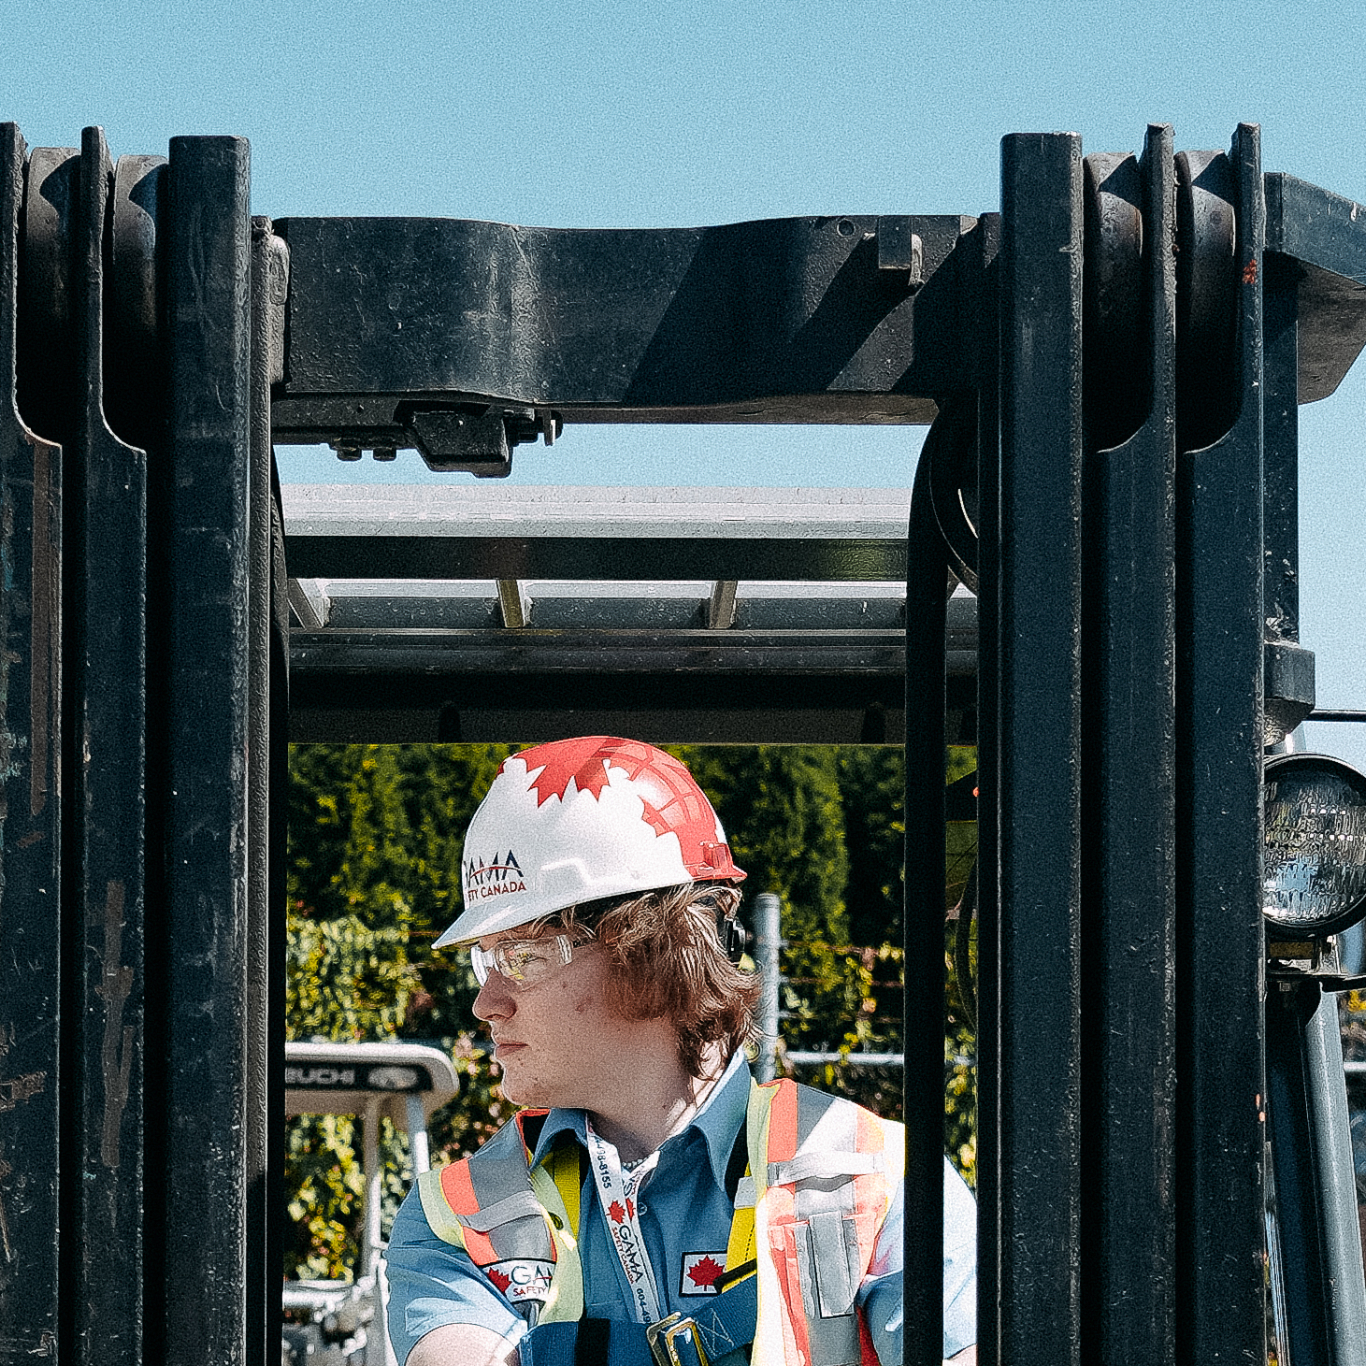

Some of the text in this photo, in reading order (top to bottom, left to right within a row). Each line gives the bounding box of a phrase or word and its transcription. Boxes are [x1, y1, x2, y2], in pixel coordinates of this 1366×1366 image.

[480, 880, 527, 898] CANADA
[618, 1224, 644, 1284] GAMA
[512, 1285, 547, 1297] SAFETY
